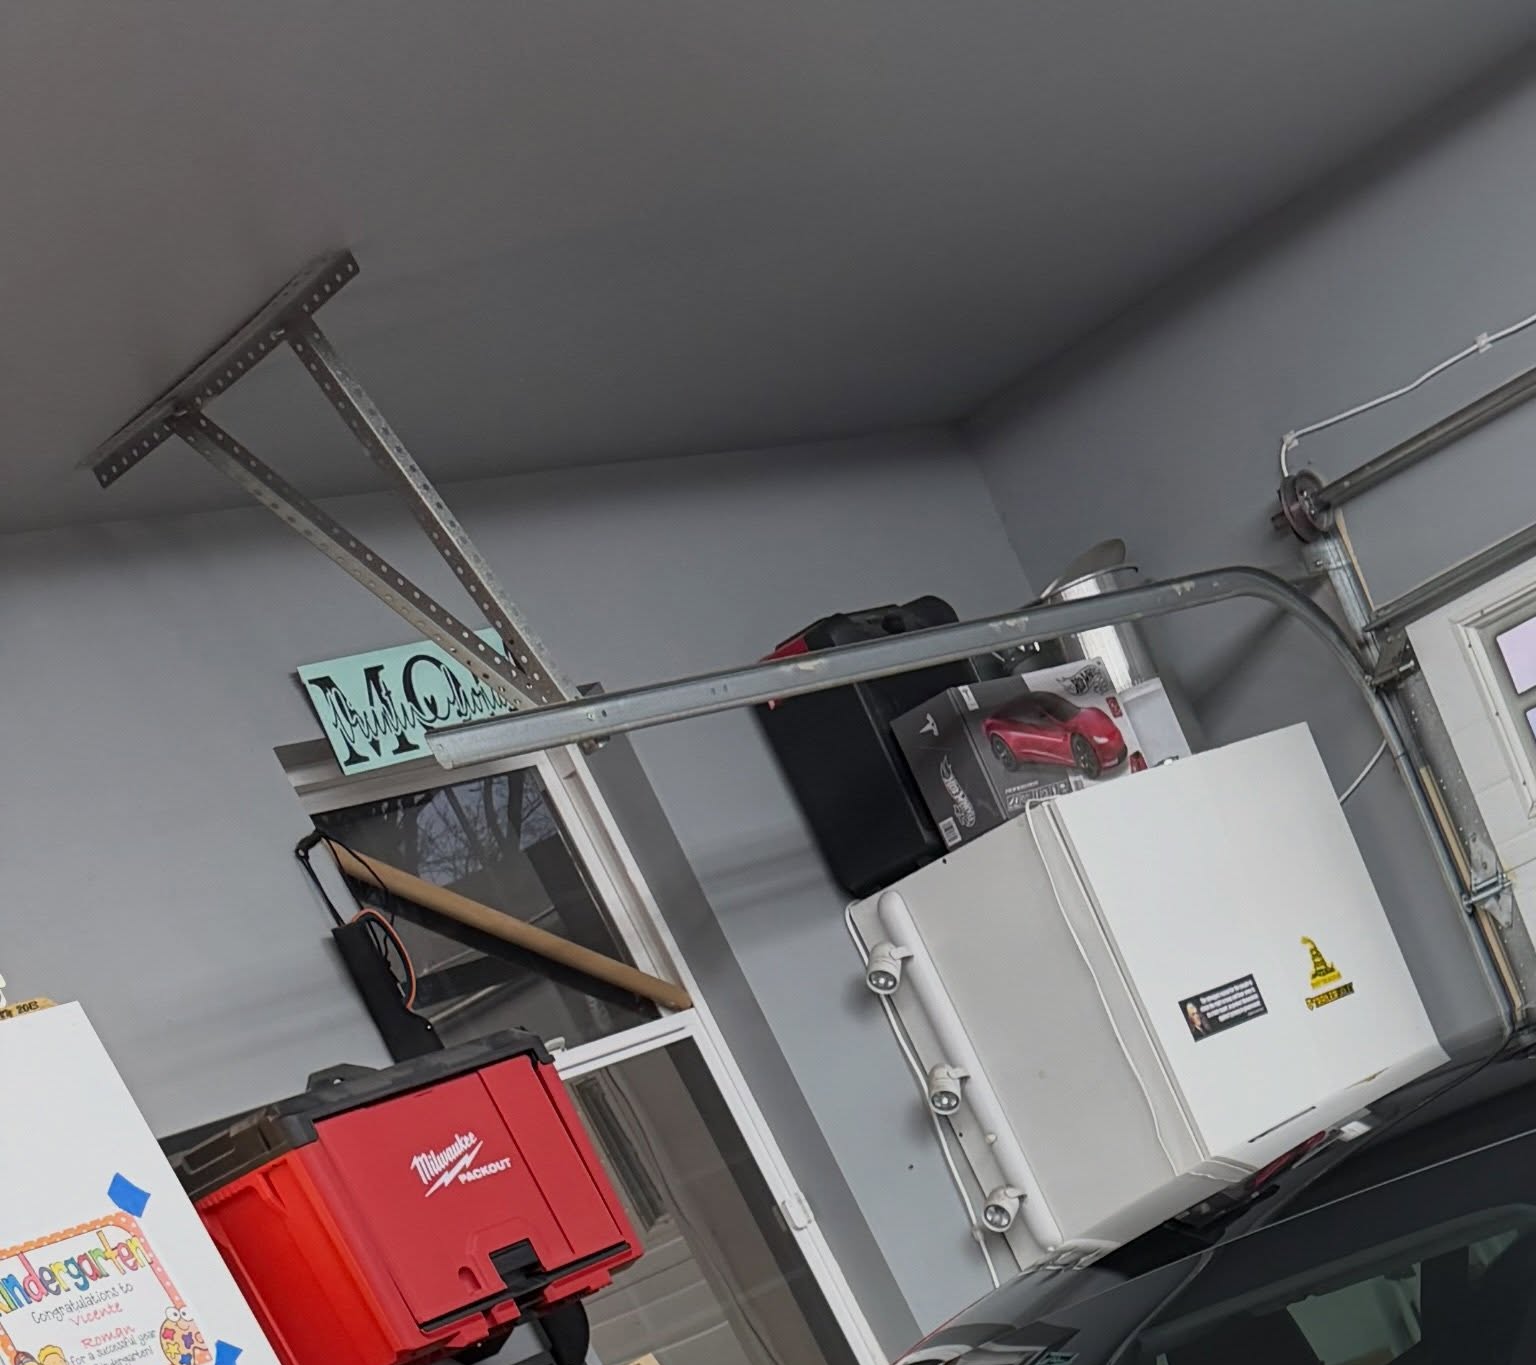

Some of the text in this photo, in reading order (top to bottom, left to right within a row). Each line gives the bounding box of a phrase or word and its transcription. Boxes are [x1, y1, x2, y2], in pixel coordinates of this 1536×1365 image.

[410, 1131, 478, 1185] Milwaukee
[457, 1157, 512, 1185] PACKOUT
[31, 1282, 134, 1324] Congratulations to
